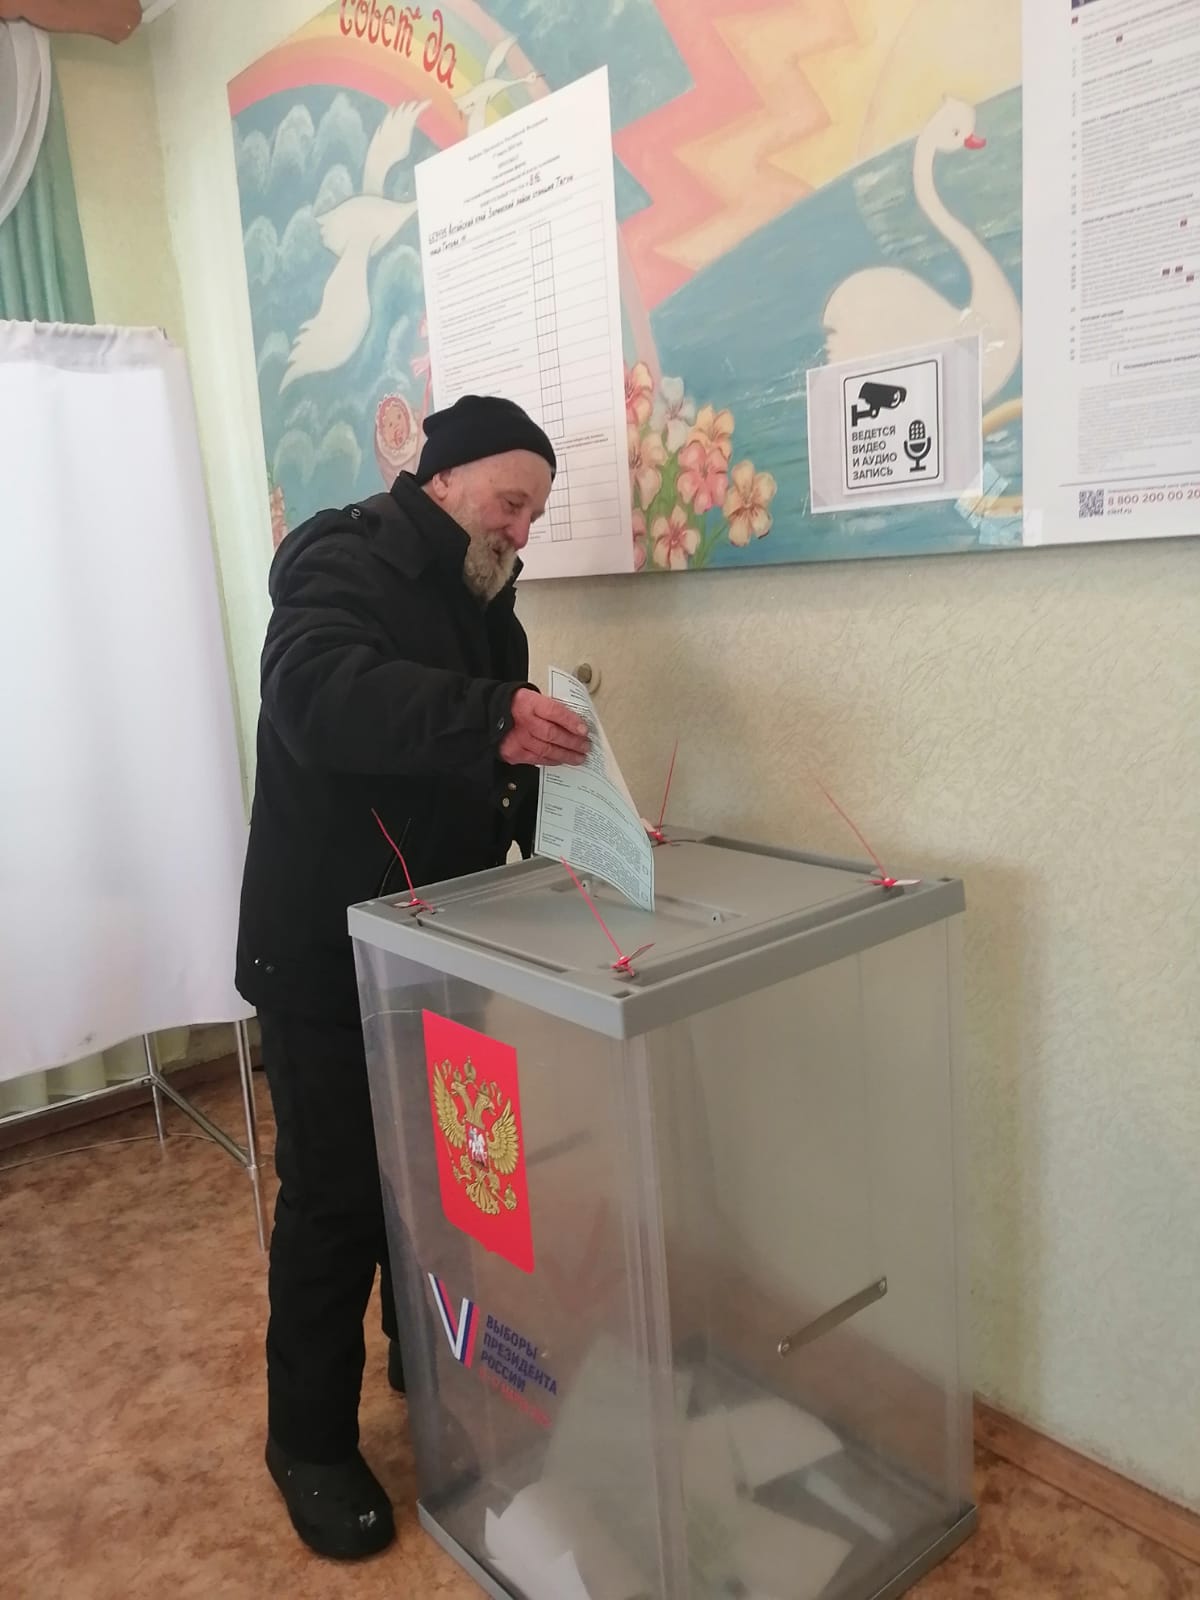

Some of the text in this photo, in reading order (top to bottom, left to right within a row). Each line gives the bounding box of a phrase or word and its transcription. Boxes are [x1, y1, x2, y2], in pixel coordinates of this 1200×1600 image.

[851, 425, 896, 441] ВЕДЕТСЯ
[852, 440, 886, 455] ВИДЕО
[853, 452, 898, 467] И АУДИО
[853, 466, 893, 481] ЗАПИСЬ
[1117, 494, 1139, 506] 800
[1142, 491, 1165, 503] 200
[1167, 489, 1184, 500] 00
[1187, 488, 1200, 499] 20
[486, 1314, 538, 1360] ВЫБОРЫ
[481, 1350, 526, 1393] РОССИИ
[483, 1332, 557, 1396] ПРЕЗИДЕНТА
